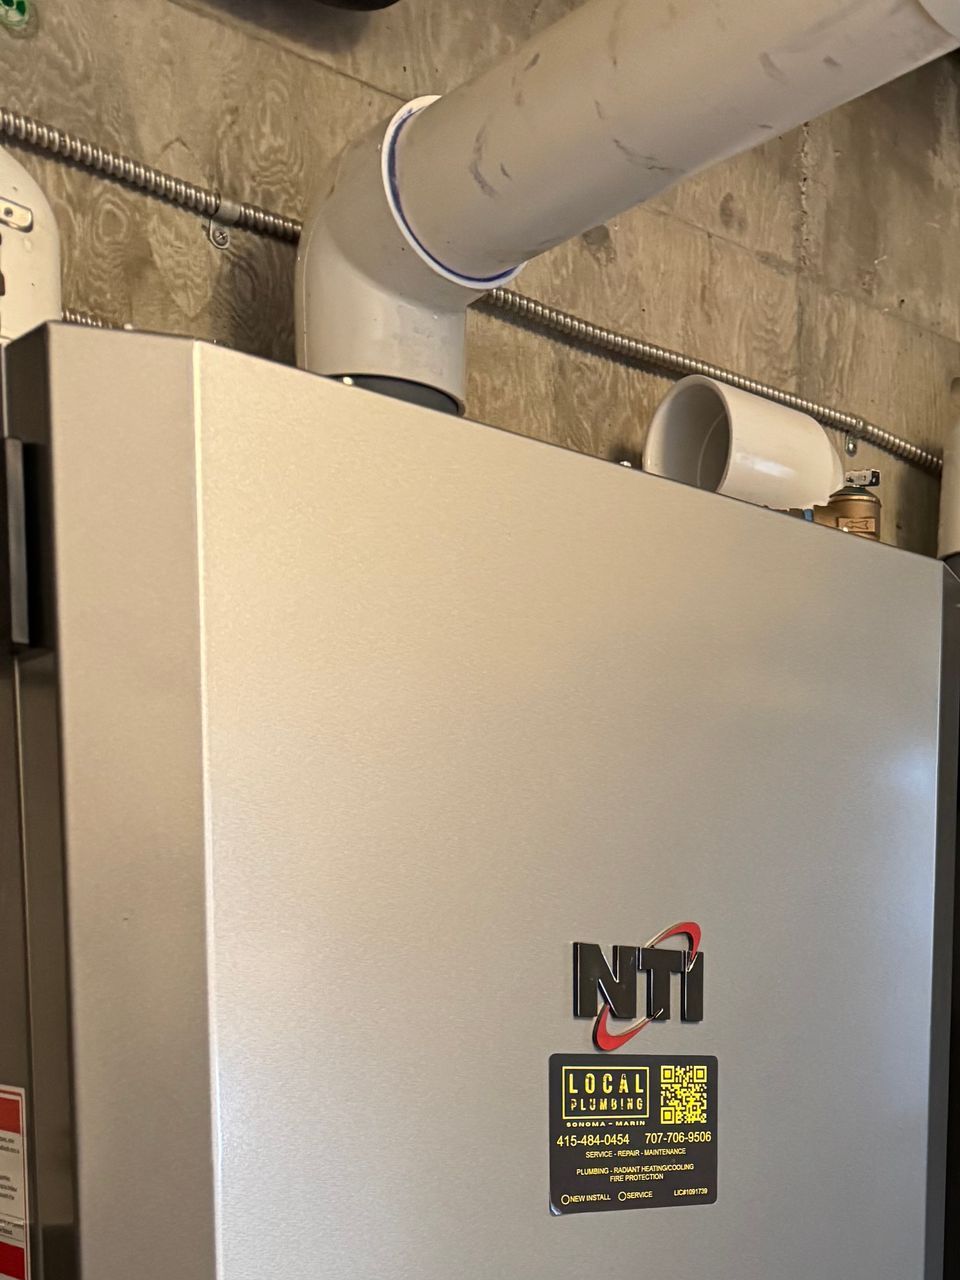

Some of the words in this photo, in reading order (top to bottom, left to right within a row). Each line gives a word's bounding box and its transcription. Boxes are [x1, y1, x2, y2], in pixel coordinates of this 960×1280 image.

[572, 941, 704, 1022] NTI
[569, 1073, 644, 1094] LOCAL
[570, 1098, 643, 1111] PLUMBING
[556, 1133, 630, 1147] 415-484-0454
[645, 1131, 712, 1144] 707-706-9506
[585, 1151, 613, 1159] SERVICE
[644, 1147, 687, 1156] MAINTENANCE
[576, 1167, 609, 1176] PLUMBING
[614, 1166, 640, 1174] RADIANT
[610, 1175, 624, 1183] FIRE
[625, 1173, 664, 1182] PROTECTION
[569, 1195, 586, 1203] NEW
[586, 1193, 611, 1202] INSTALL
[627, 1190, 653, 1199] SERVICE
